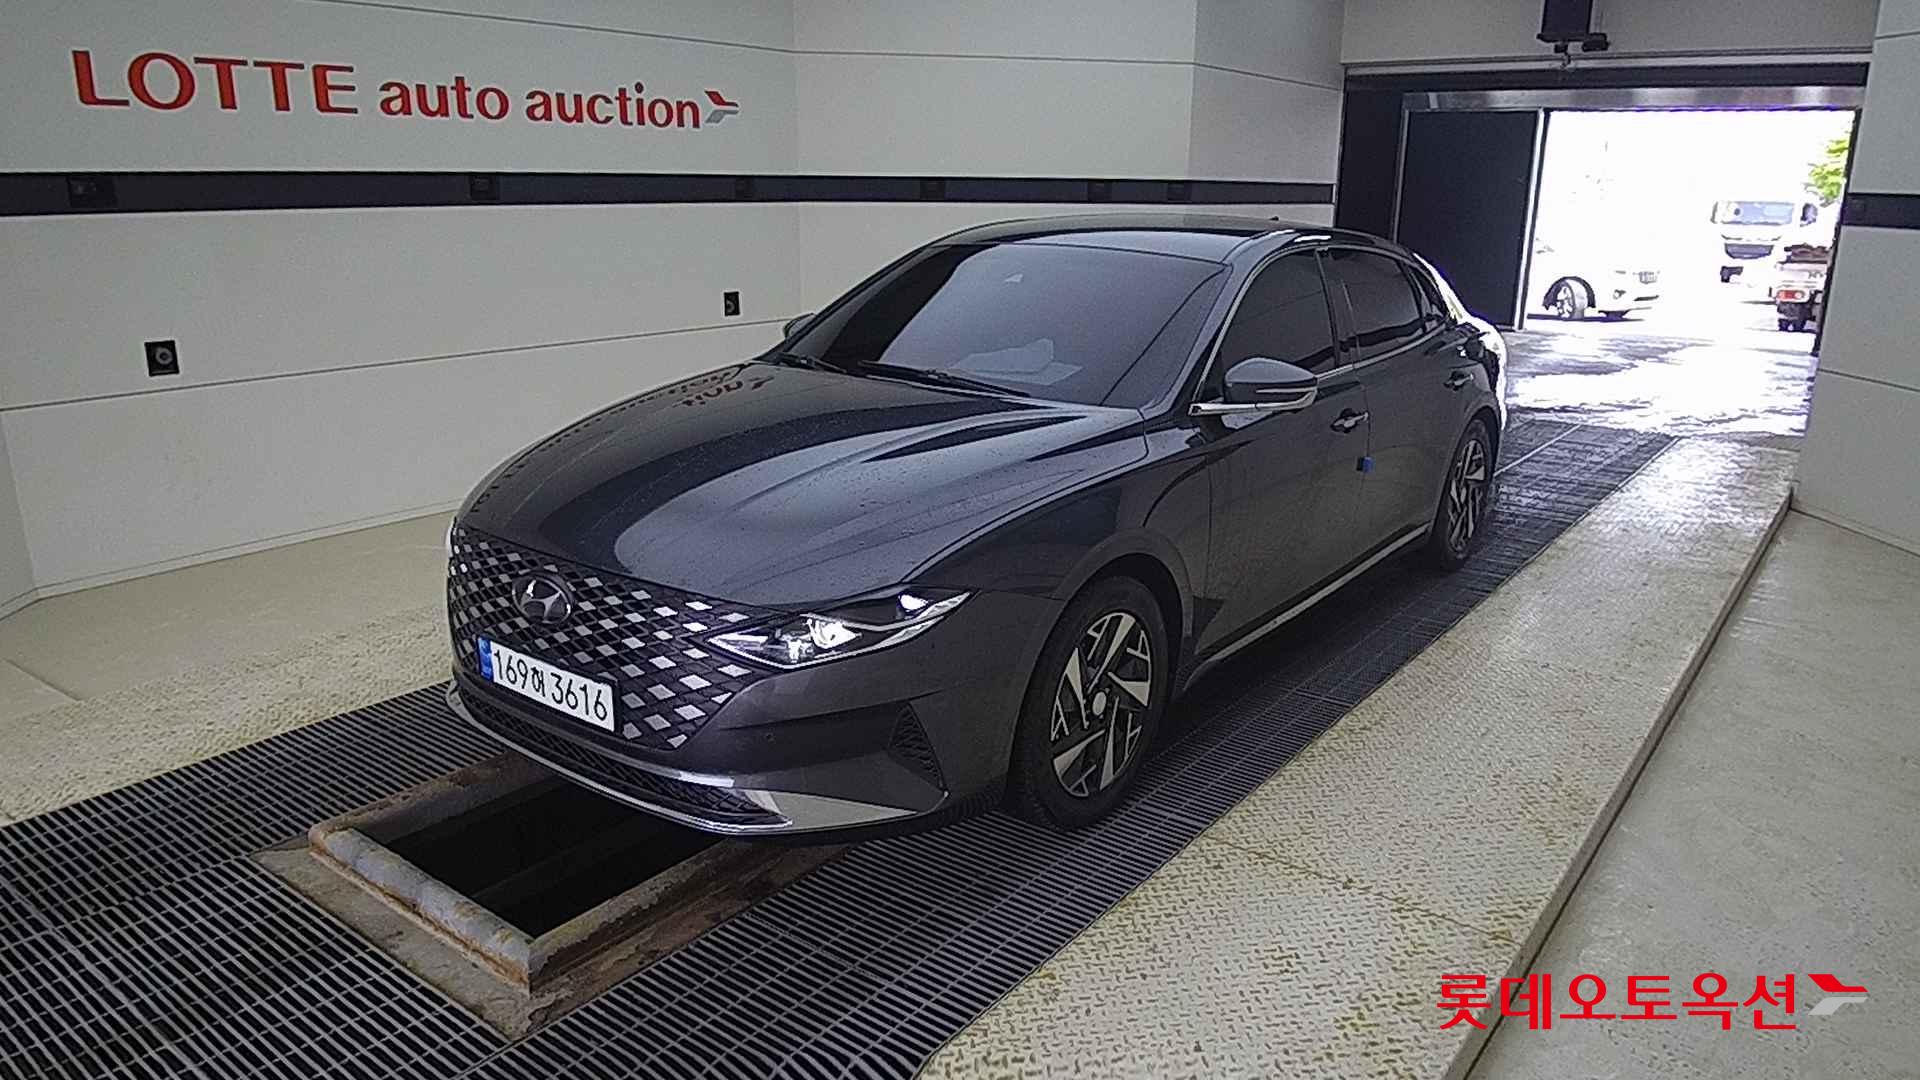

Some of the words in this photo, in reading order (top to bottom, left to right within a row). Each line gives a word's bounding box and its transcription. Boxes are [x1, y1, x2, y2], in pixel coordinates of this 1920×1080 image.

[72, 50, 358, 115] LOTTE
[379, 77, 509, 118] auto
[526, 82, 702, 127] auction
[551, 673, 608, 721] 3616
